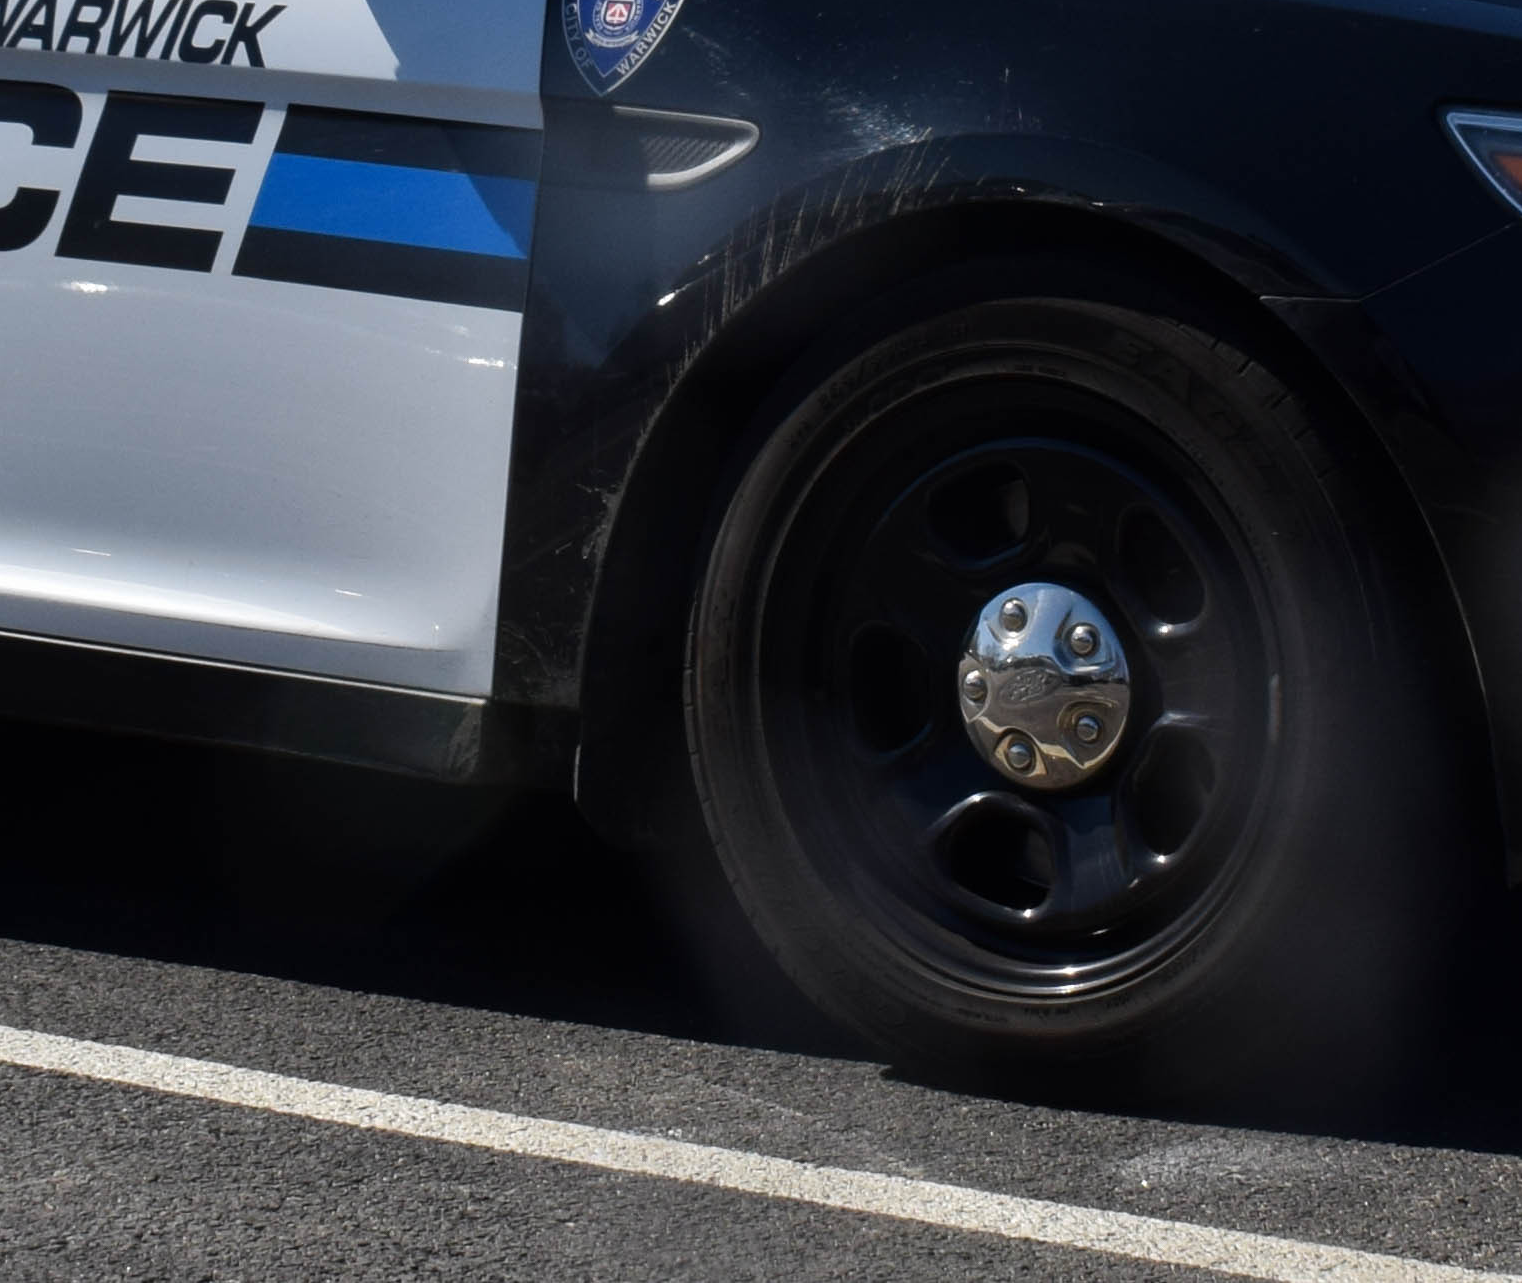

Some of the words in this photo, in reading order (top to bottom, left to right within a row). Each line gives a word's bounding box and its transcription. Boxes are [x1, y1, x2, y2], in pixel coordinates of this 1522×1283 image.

[566, 3, 581, 42] CITY
[575, 47, 594, 69] OF
[616, 1, 676, 76] WARWICK
